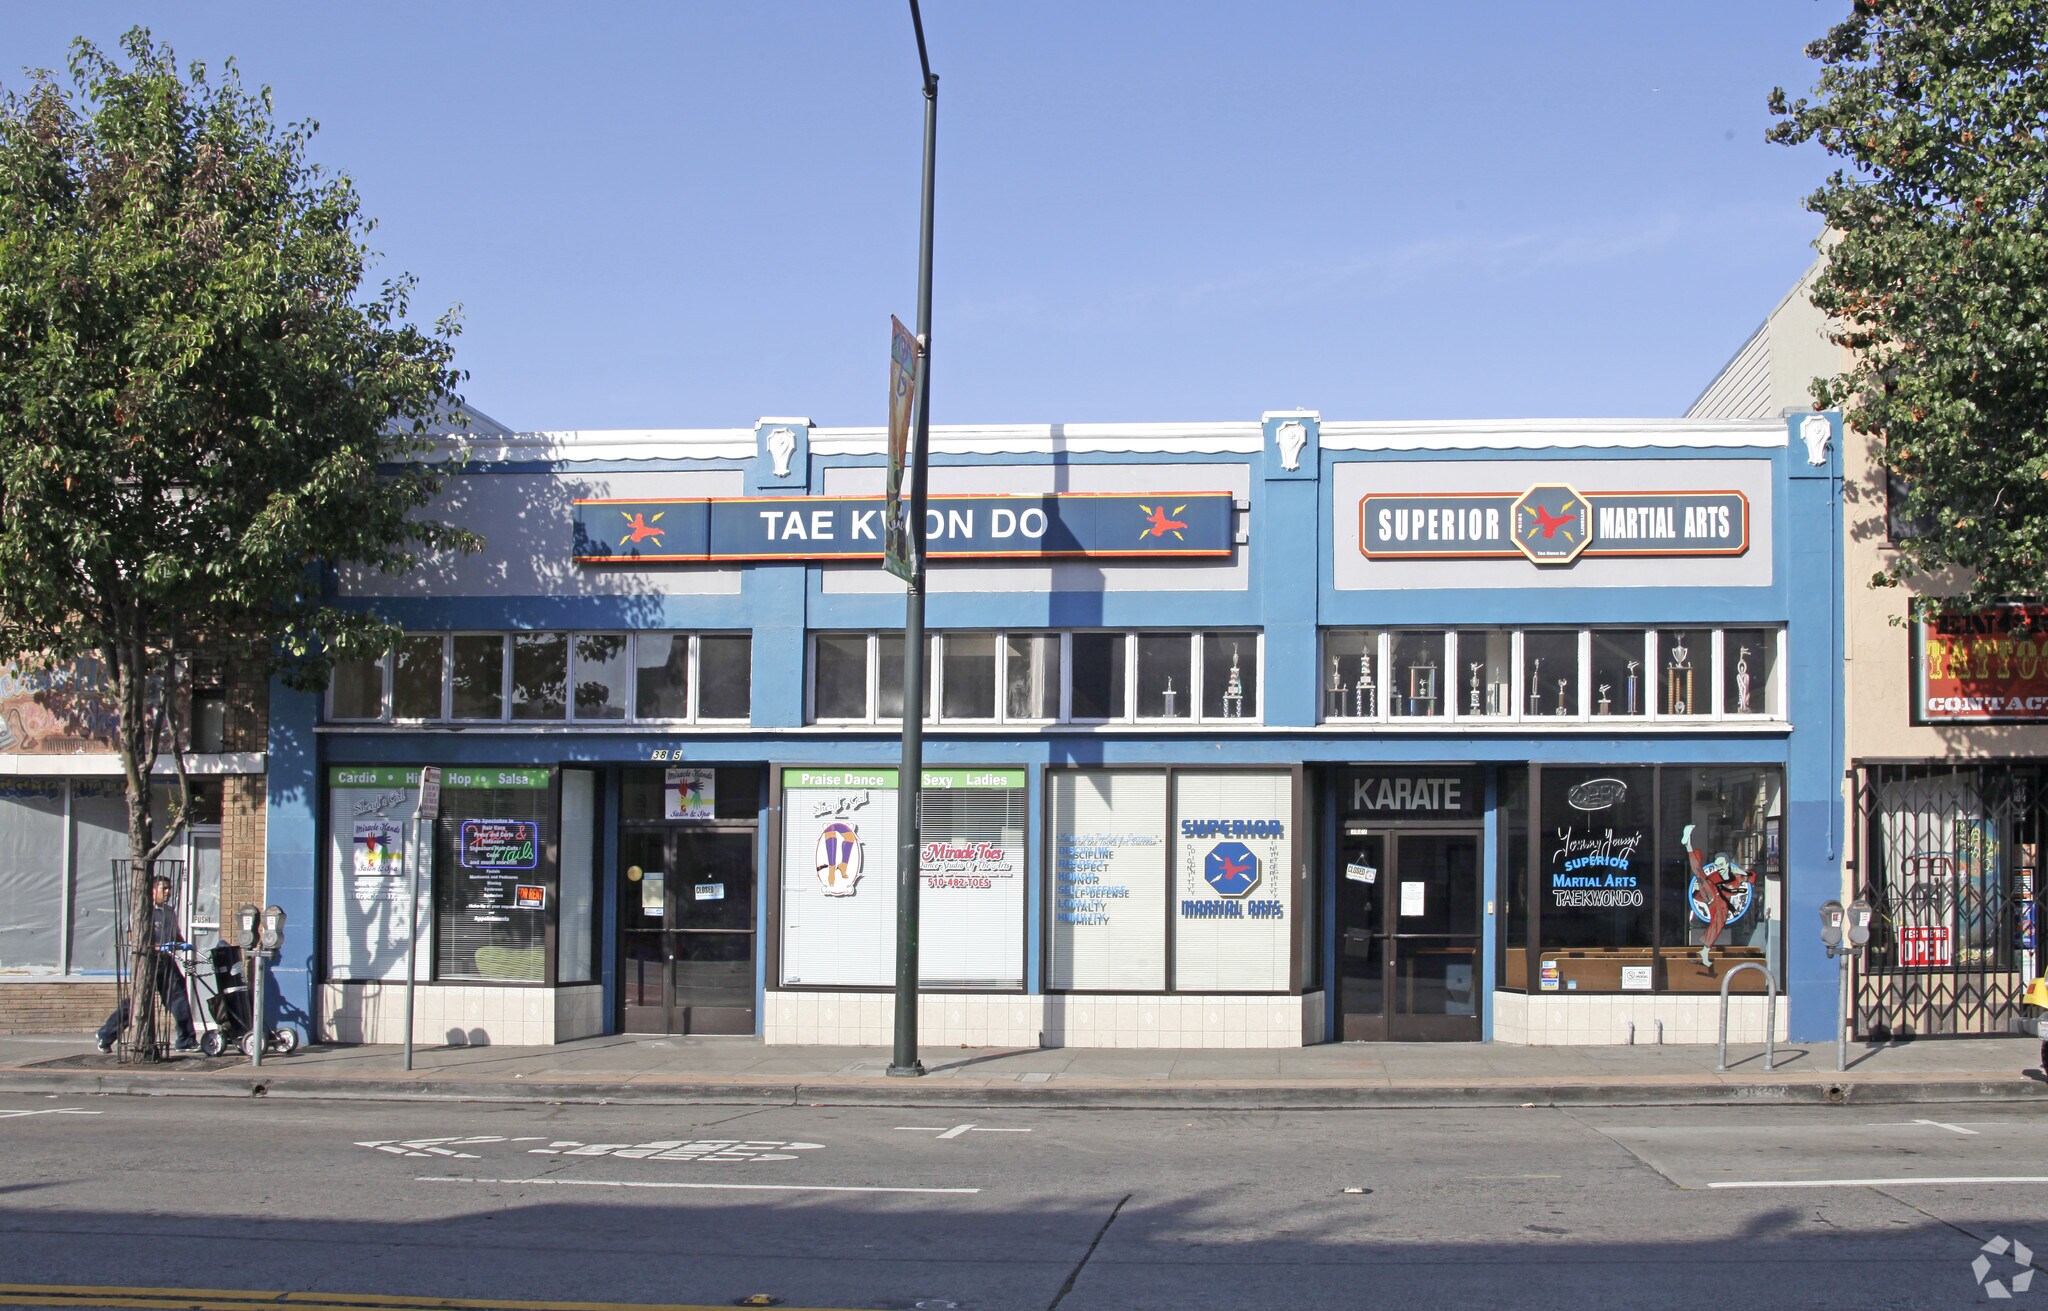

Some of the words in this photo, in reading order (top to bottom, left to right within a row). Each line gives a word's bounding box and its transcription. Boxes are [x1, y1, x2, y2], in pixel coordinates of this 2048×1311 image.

[760, 510, 834, 541] TAE
[991, 508, 1048, 538] DO
[1379, 508, 1499, 541] SUPERIOR
[1600, 507, 1676, 539] MARTIAL
[1684, 505, 1730, 538] ARTS
[338, 772, 377, 783] Cardio
[406, 772, 421, 783] Hi
[449, 773, 471, 786] Hop
[498, 773, 528, 785] Salsa
[667, 770, 691, 780] Miracle
[692, 768, 713, 780] Hands
[801, 773, 841, 785] Praise
[844, 773, 884, 785] Dance
[923, 773, 953, 788] Sexy
[966, 773, 1008, 785] Ladies
[1354, 778, 1461, 810] KARATE
[670, 809, 689, 817] Salon
[697, 809, 711, 819] Spa
[355, 823, 379, 834] Miracle
[379, 822, 401, 834] Hands
[515, 825, 527, 840] &
[1181, 819, 1281, 835] SUPERIOR
[921, 843, 976, 861] Miracle
[977, 843, 1003, 860] Toes
[1059, 846, 1110, 855] DISCIPLINE
[384, 864, 398, 874] Spa
[1058, 860, 1105, 868] RESPECT
[1565, 856, 1629, 871] SUPERIOR
[1058, 872, 1095, 880] HONOR
[1347, 865, 1366, 876] CLOSED
[928, 878, 990, 887] 510-482-TOES
[1553, 874, 1602, 888] MARTIAL
[1604, 874, 1637, 888] ARTS
[696, 885, 714, 894] CLOSED
[1058, 886, 1127, 894] SELF-DEFENSE
[1058, 899, 1103, 908] LOYALTY
[1553, 889, 1643, 906] TAEKWONDO
[1181, 900, 1241, 915] MARTIAL
[1248, 900, 1281, 915] ARTS
[1058, 913, 1107, 921] HUMILITY
[1901, 940, 1948, 961] OPEN
